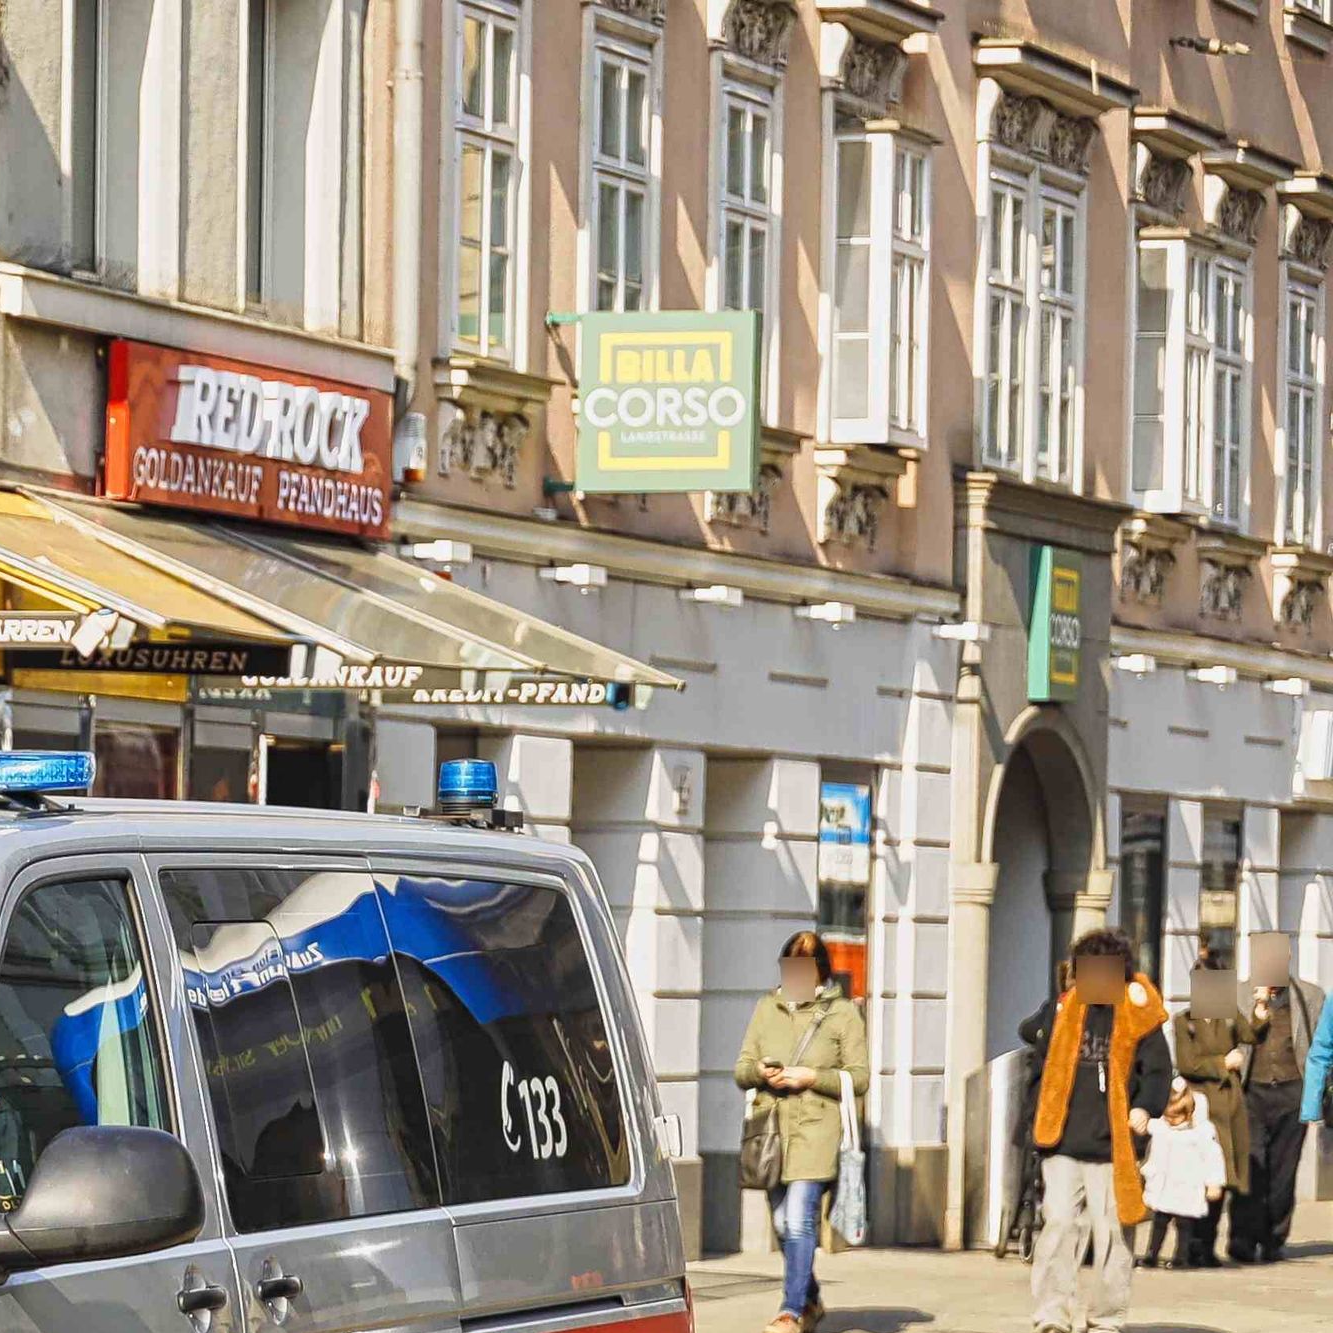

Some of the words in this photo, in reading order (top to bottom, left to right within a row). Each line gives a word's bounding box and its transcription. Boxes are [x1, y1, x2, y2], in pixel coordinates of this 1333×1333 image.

[584, 386, 746, 427] CORSO
[617, 349, 714, 383] BILLA
[170, 364, 264, 454] RED
[258, 381, 370, 474] ROCK
[132, 446, 263, 504] GOLDANKAUF
[277, 470, 382, 527] PFANDHAUS
[518, 1075, 568, 1159] 133
